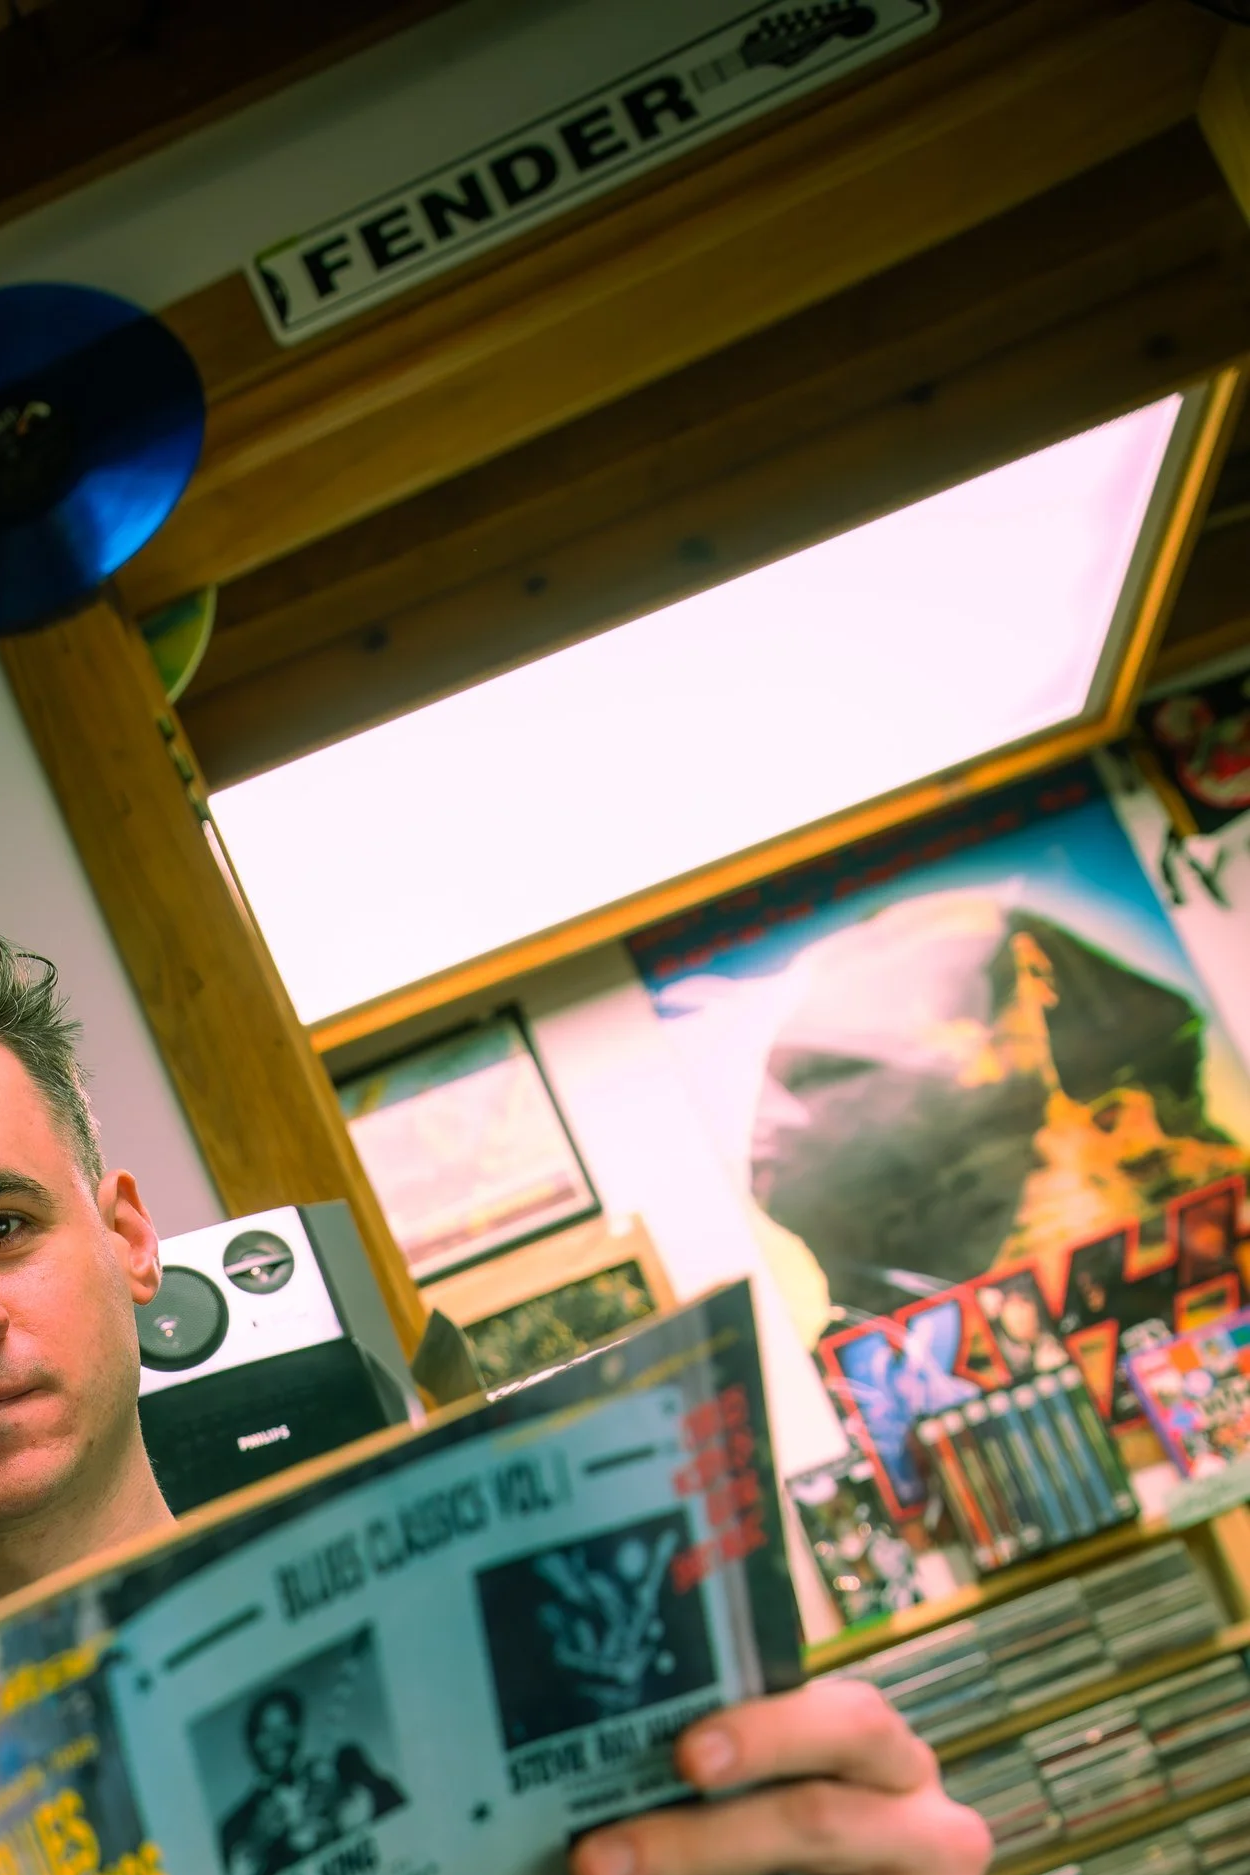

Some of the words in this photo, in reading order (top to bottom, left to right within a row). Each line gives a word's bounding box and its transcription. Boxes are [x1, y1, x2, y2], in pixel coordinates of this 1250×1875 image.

[302, 73, 699, 298] FENDER
[237, 1424, 291, 1452] PHILIPS
[275, 1541, 363, 1624] BLUES
[364, 1478, 488, 1576] CLASSICS
